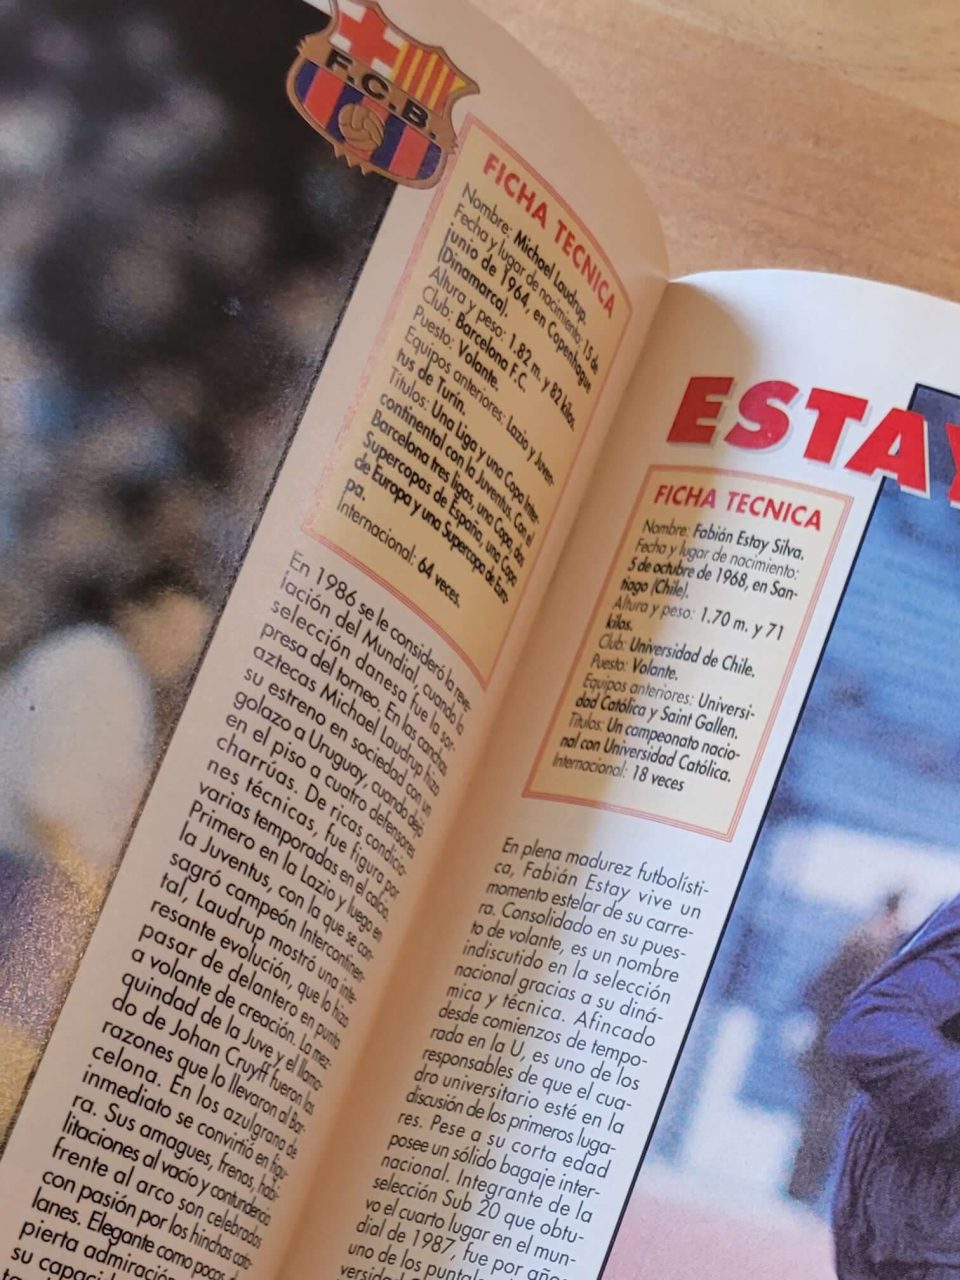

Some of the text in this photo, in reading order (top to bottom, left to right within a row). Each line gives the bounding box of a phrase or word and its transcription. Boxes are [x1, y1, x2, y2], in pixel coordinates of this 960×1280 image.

[462, 183, 586, 325] Nombre: Michael Laudrup.
[483, 153, 615, 319] FICHA TECNICA
[414, 305, 498, 392] Puesto: Volante.
[424, 286, 527, 392] Club: Barcelona F.C.
[653, 484, 821, 531] FICHA TECNICA
[337, 497, 460, 608] Internacional: 64 veces.
[633, 536, 799, 580] Fecha y lugar de nacimiento:
[641, 517, 804, 560] Nombre: Fabián Estay Silva.
[619, 575, 688, 599] tiago (Chile).
[626, 554, 797, 600] 5 de octubre de 1968, en San-
[289, 553, 310, 576] En
[315, 566, 357, 607] 1986
[357, 602, 375, 621] se
[375, 606, 389, 632] le
[389, 626, 445, 681] consideró
[444, 668, 455, 692] la
[604, 613, 633, 631] kilos.
[611, 593, 784, 641] Altura y peso: 1.70 m. y 71
[272, 600, 351, 660] selección
[354, 651, 407, 703] danesa
[409, 691, 428, 722] fue
[428, 710, 440, 735] la
[589, 651, 678, 680] Puesto: Volante.
[597, 631, 755, 677] Club: Universidad de Chile.
[574, 690, 737, 739] dad Católica y Saint Gallen.
[581, 671, 755, 720] Equipos anteriores: Universi-
[558, 731, 731, 782] nal con Universidad Católica.
[605, 715, 623, 735] Un
[624, 724, 699, 751] campeonato
[700, 741, 740, 760] nacio-
[550, 751, 685, 792] Internacional: 18 veces
[493, 860, 701, 919] ca, Fabián Estay vive un
[501, 835, 709, 896] En plena madurez futbolísti-
[476, 900, 686, 960] ra. Consolidado en su pues-
[485, 882, 693, 938] momento estelar de su carre-
[461, 938, 671, 1004] indiscutido en la selección
[445, 982, 655, 1047] mica y técnica. Afincado
[413, 1063, 625, 1134] dro universitario esté en la
[421, 1048, 631, 1111] responsables de que el cua-
[371, 1173, 584, 1243] selección Sub 20 que obtu-
